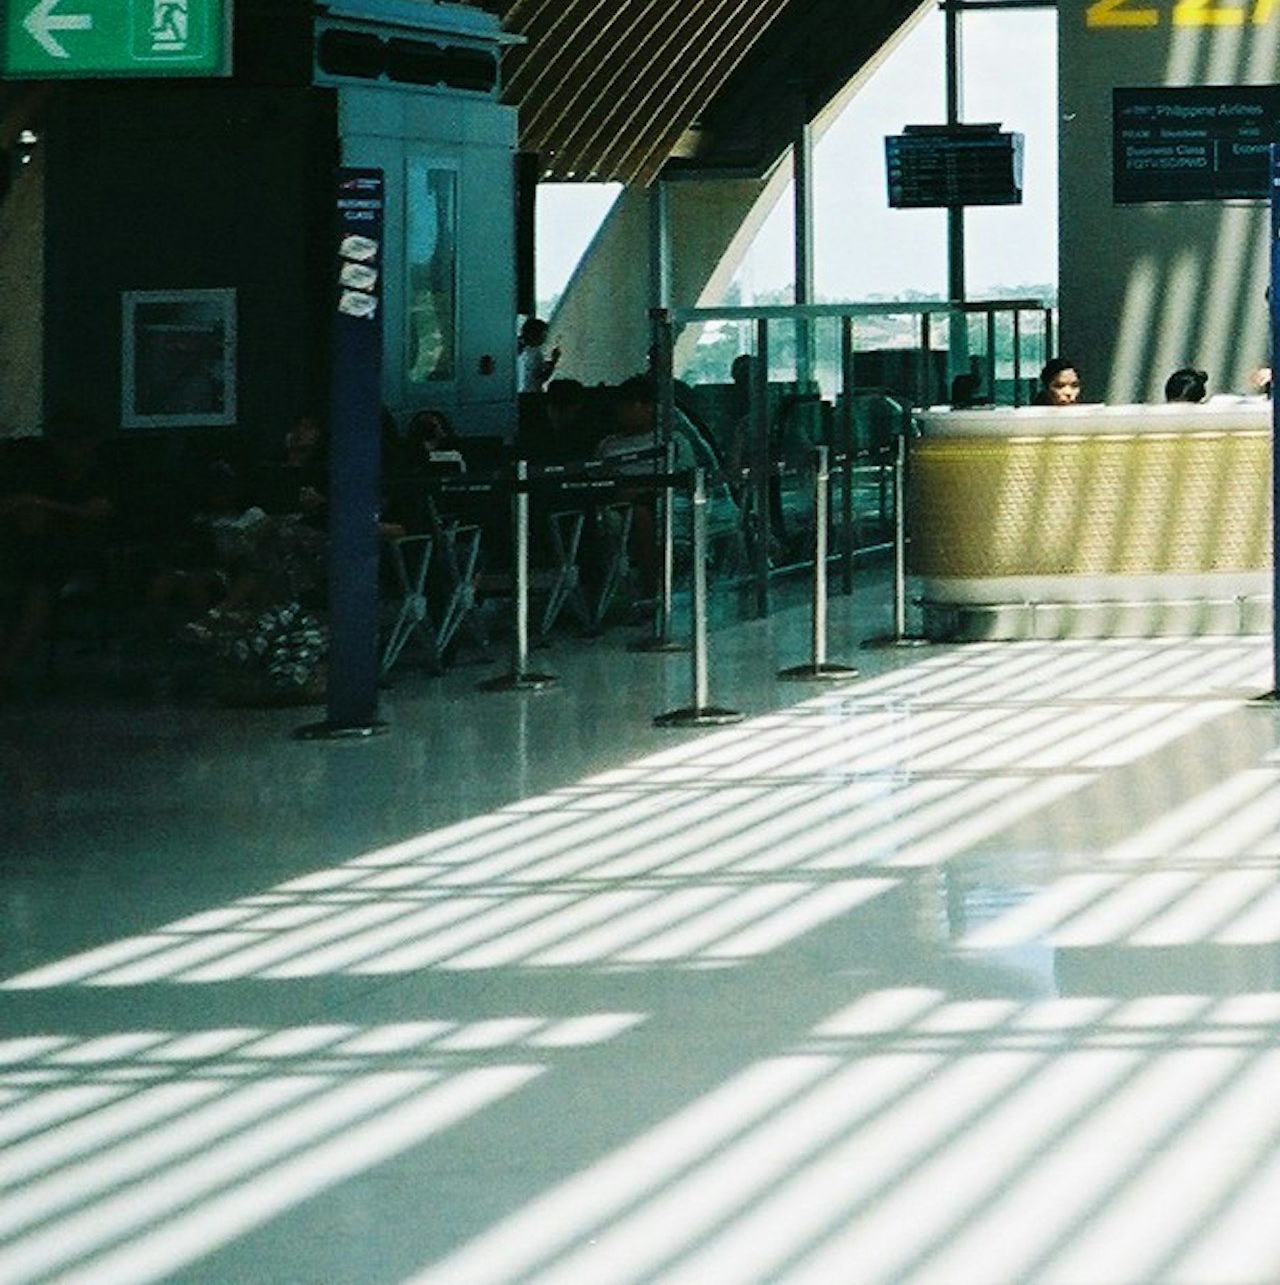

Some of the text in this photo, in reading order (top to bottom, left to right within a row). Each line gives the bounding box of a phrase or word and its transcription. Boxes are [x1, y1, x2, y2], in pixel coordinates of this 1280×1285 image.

[1218, 103, 1264, 116] Airlines
[1126, 145, 1206, 157] Business Class
